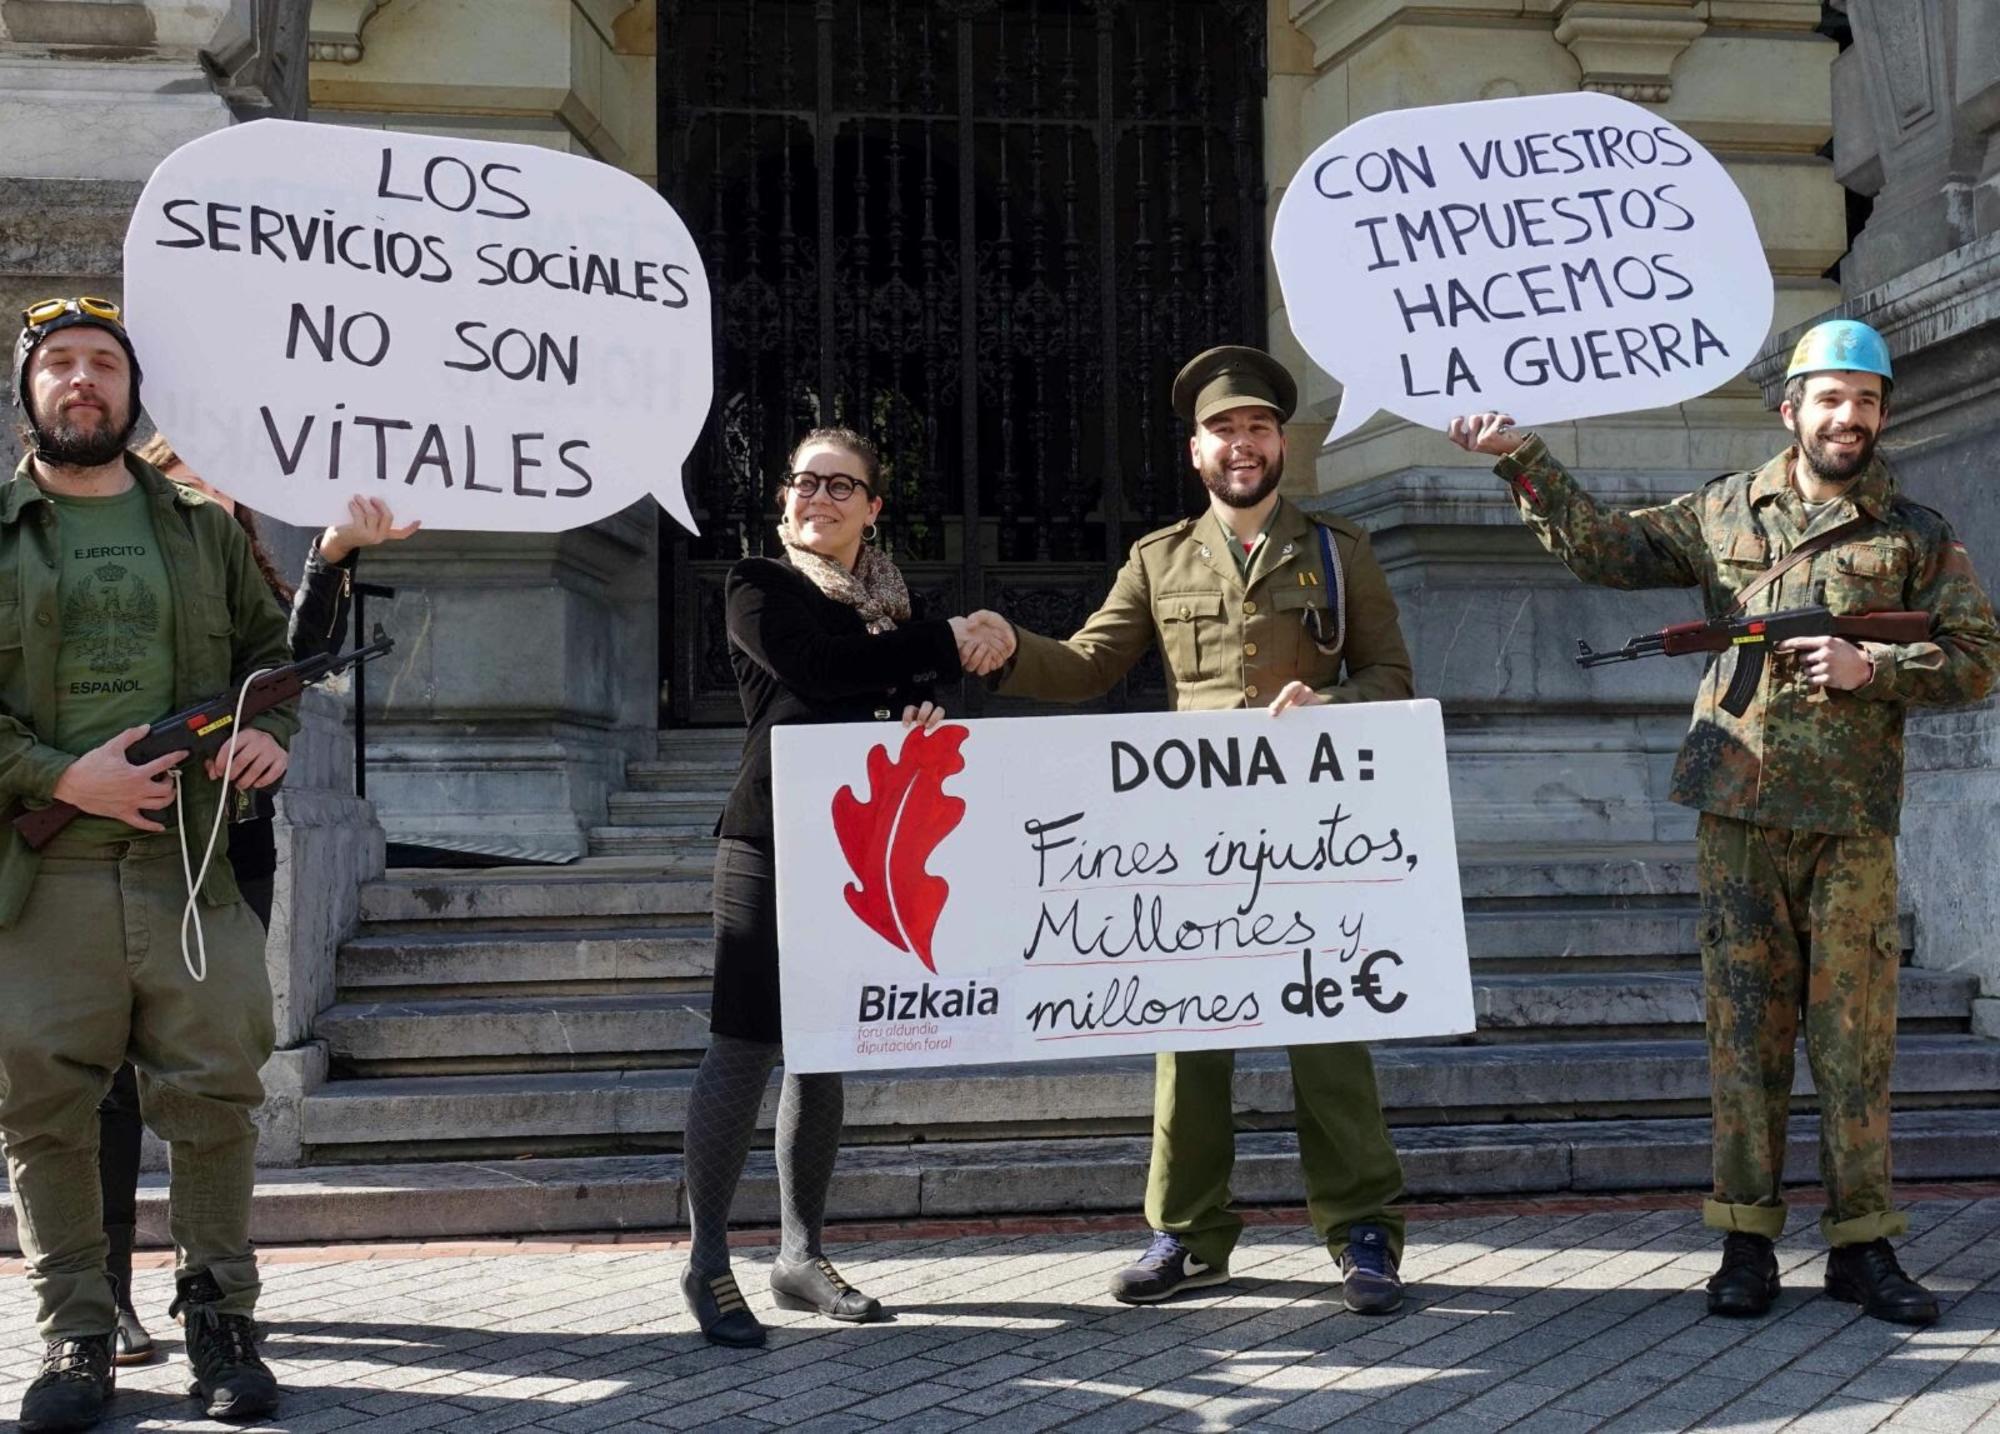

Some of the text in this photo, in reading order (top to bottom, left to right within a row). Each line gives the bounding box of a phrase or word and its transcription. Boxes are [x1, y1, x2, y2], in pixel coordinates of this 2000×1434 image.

[377, 147, 531, 220] LOS
[1313, 126, 1693, 199] CON VUESTROS
[1354, 183, 1695, 272] IMPUESTOS
[1393, 253, 1694, 334] HACEMOS
[285, 302, 579, 386] NO SON
[1399, 317, 1730, 397] LA GUERRA
[74, 545, 146, 560] EJERCITO
[69, 678, 145, 695] ESPAÑOL
[1110, 736, 1287, 793] DONA
[1024, 803, 1418, 916] Fines injustos,
[1023, 892, 1364, 963] Millones y
[858, 980, 999, 1023] Bizkaia
[858, 1022, 939, 1040] foru aldundia
[1026, 975, 1260, 1032] millones
[857, 1036, 952, 1055] diputación foral
